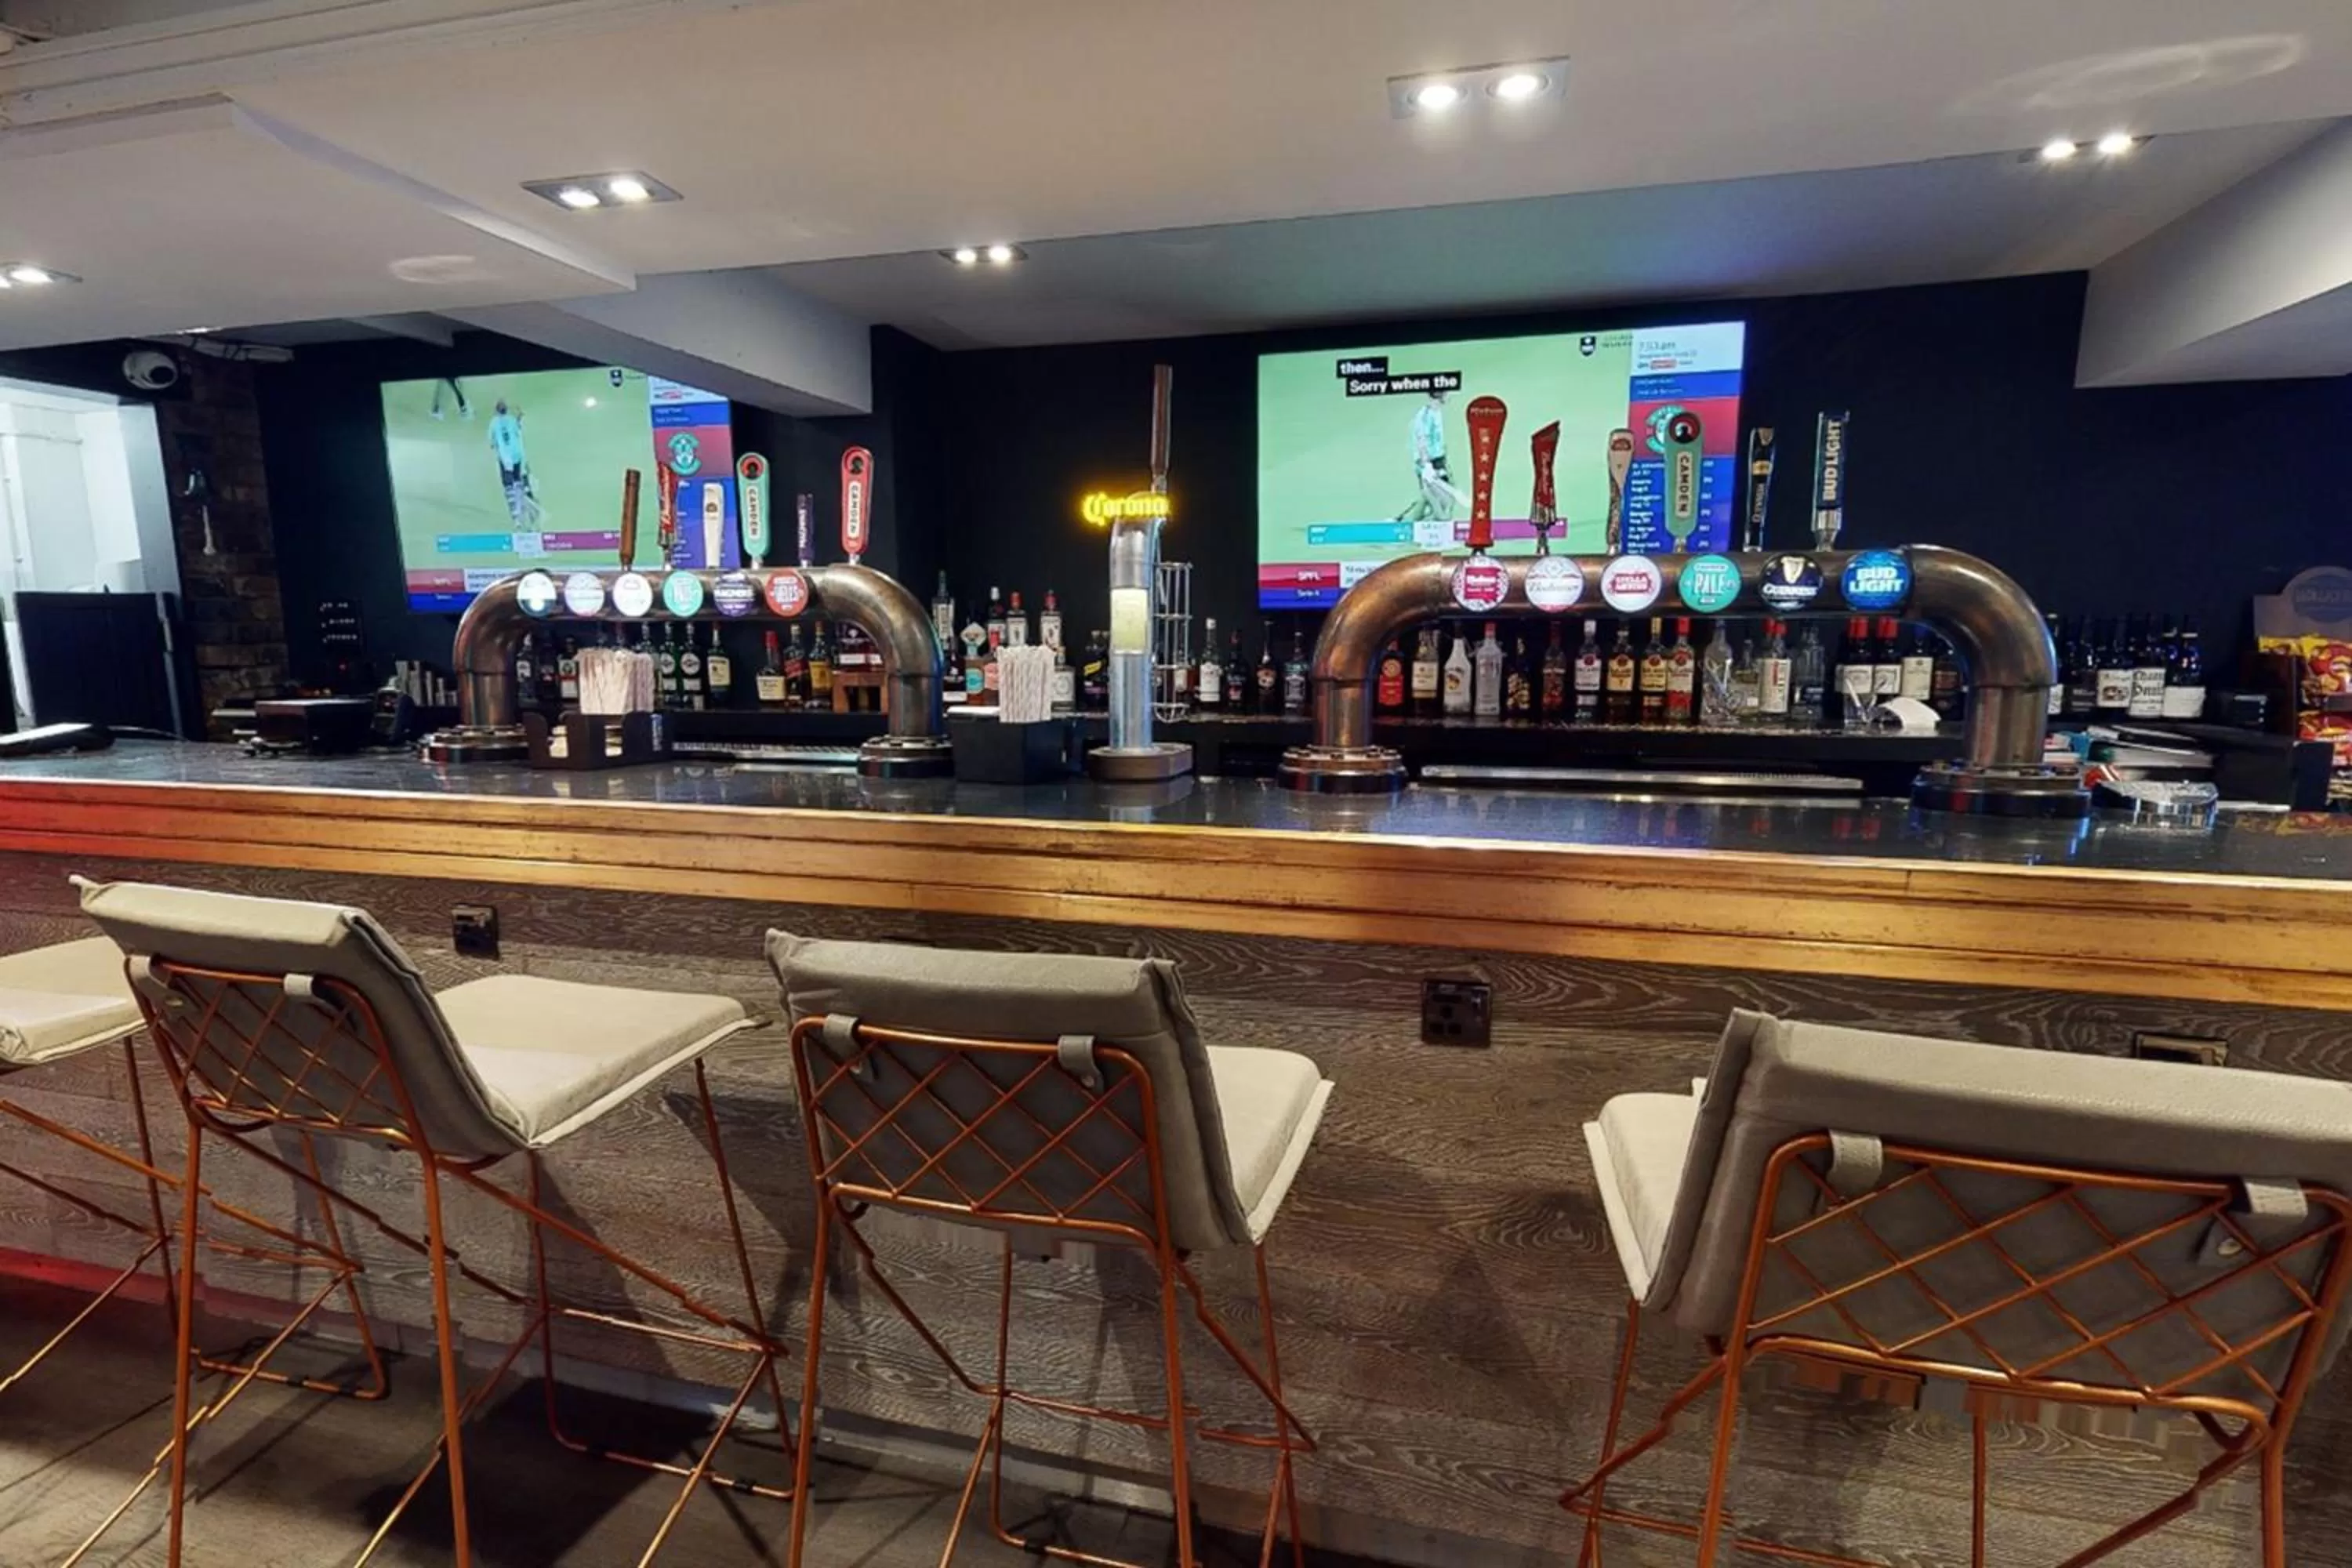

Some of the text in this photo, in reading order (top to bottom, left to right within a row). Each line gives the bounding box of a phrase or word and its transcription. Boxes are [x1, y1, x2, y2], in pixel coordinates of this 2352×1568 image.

[1349, 375, 1458, 394] Sorry when the
[1823, 419, 1842, 501] BUD LIGHT
[1679, 456, 1690, 513] CAMDEN
[748, 488, 760, 536] CAMDEN
[1082, 492, 1171, 527] Corona
[1694, 572, 1726, 595] PALE
[1849, 579, 1904, 593] LIGHT
[1856, 566, 1897, 580] BUD
